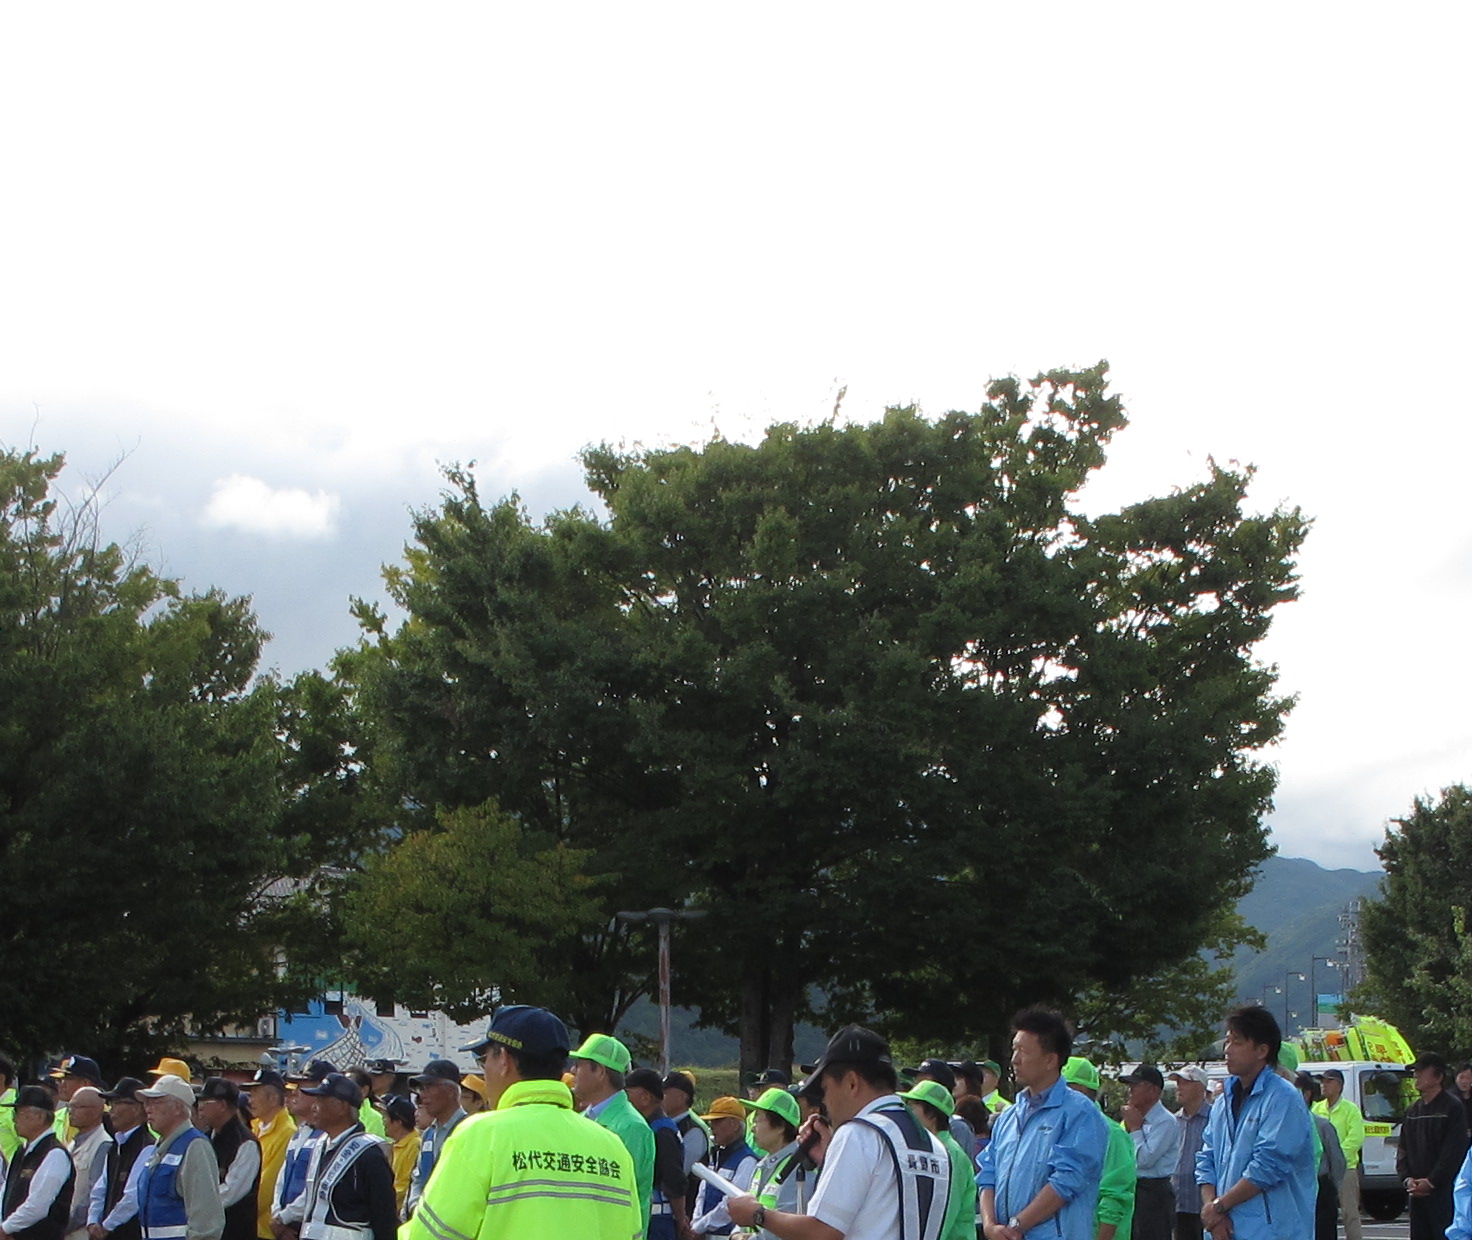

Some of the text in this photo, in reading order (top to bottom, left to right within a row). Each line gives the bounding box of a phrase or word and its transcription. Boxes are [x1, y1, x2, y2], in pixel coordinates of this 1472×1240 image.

[513, 1150, 621, 1179] 松代交通安全協会
